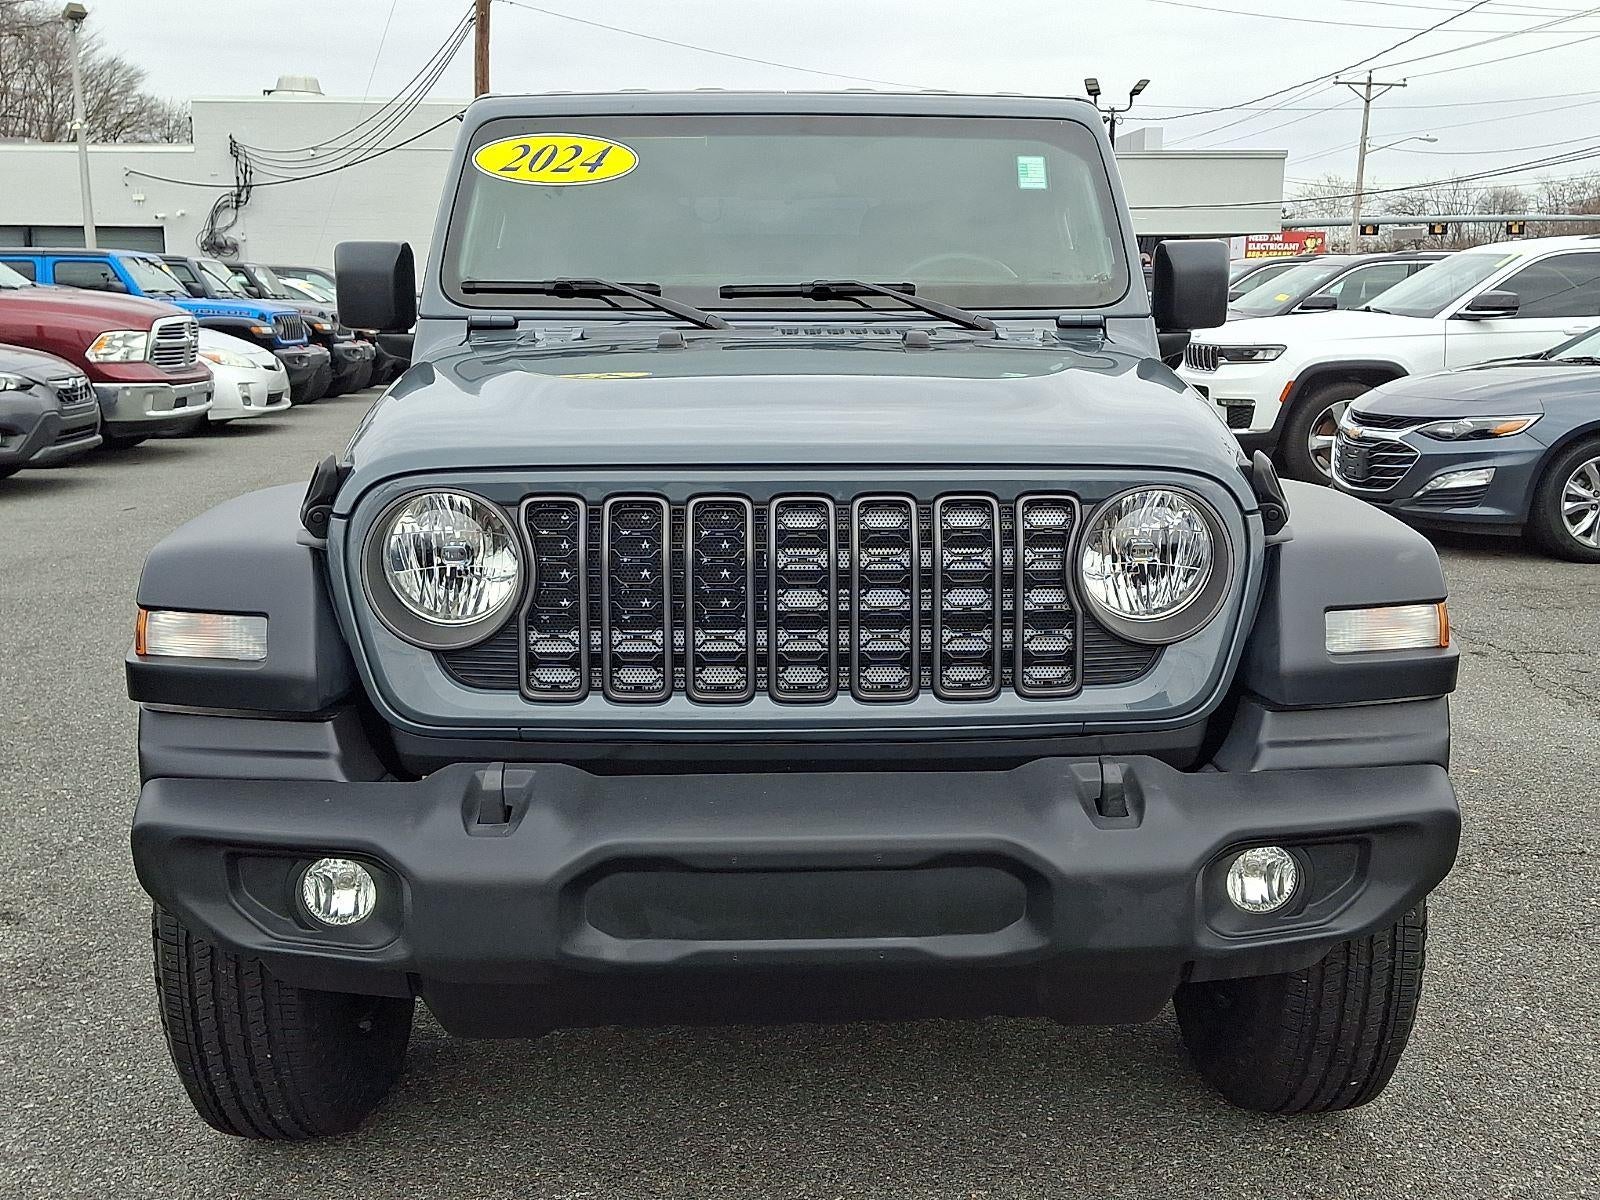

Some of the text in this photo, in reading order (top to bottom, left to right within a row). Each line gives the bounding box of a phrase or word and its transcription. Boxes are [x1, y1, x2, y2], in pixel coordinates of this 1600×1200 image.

[498, 144, 613, 173] 2024
[1271, 234, 1283, 242] AN
[188, 308, 250, 316] UBICON
